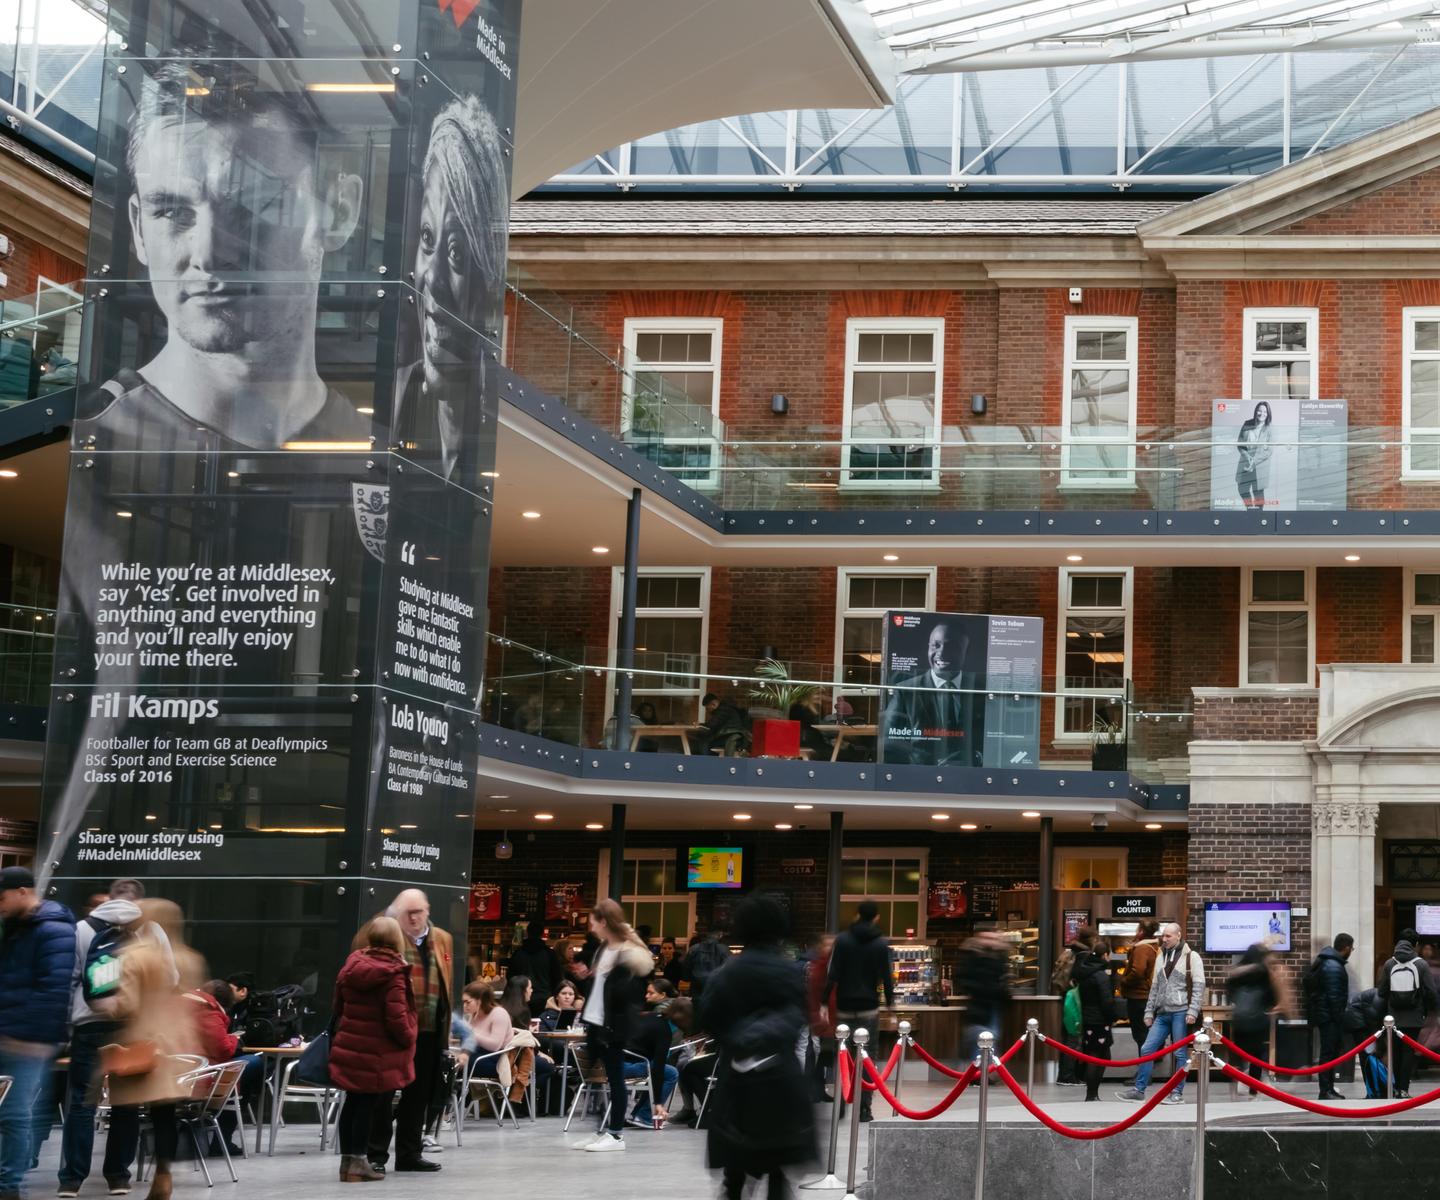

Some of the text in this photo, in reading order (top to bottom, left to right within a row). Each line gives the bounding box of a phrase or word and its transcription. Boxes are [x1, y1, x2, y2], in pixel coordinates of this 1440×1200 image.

[478, 16, 506, 55] Made in
[476, 34, 511, 80] Middlesex
[102, 563, 336, 585] While you're at Middlesex,
[99, 588, 129, 606] say
[186, 586, 216, 602] Get
[222, 584, 298, 602] involved
[303, 585, 319, 603] in
[400, 576, 474, 619] Studying at Middlesex
[97, 605, 316, 628] anything and everything
[398, 600, 459, 633] gave me fantastic
[95, 627, 293, 650] and you'll really enjoy
[397, 617, 461, 654] skills which enable
[93, 649, 238, 670] your time there.
[395, 641, 461, 673] me to do what I do
[394, 661, 466, 695] now with confidence.
[90, 692, 219, 725] Fil Kamps
[391, 704, 449, 745] Lola Young
[86, 736, 328, 753] Footballer for Team GB at Deaflympics
[86, 753, 277, 768] BSc Sport and Exercise Science
[389, 746, 463, 773] Baroness in the House of Lords
[84, 770, 173, 783] Class of 2016
[387, 778, 423, 796] Class of 1988
[388, 763, 469, 789] BA Contemporary Cultural Studies
[78, 831, 224, 847] Share your story using
[382, 838, 440, 860] Share your story using
[78, 848, 201, 861] #MadeInMiddlesex
[382, 856, 431, 872] #MadeInMiddlesex
